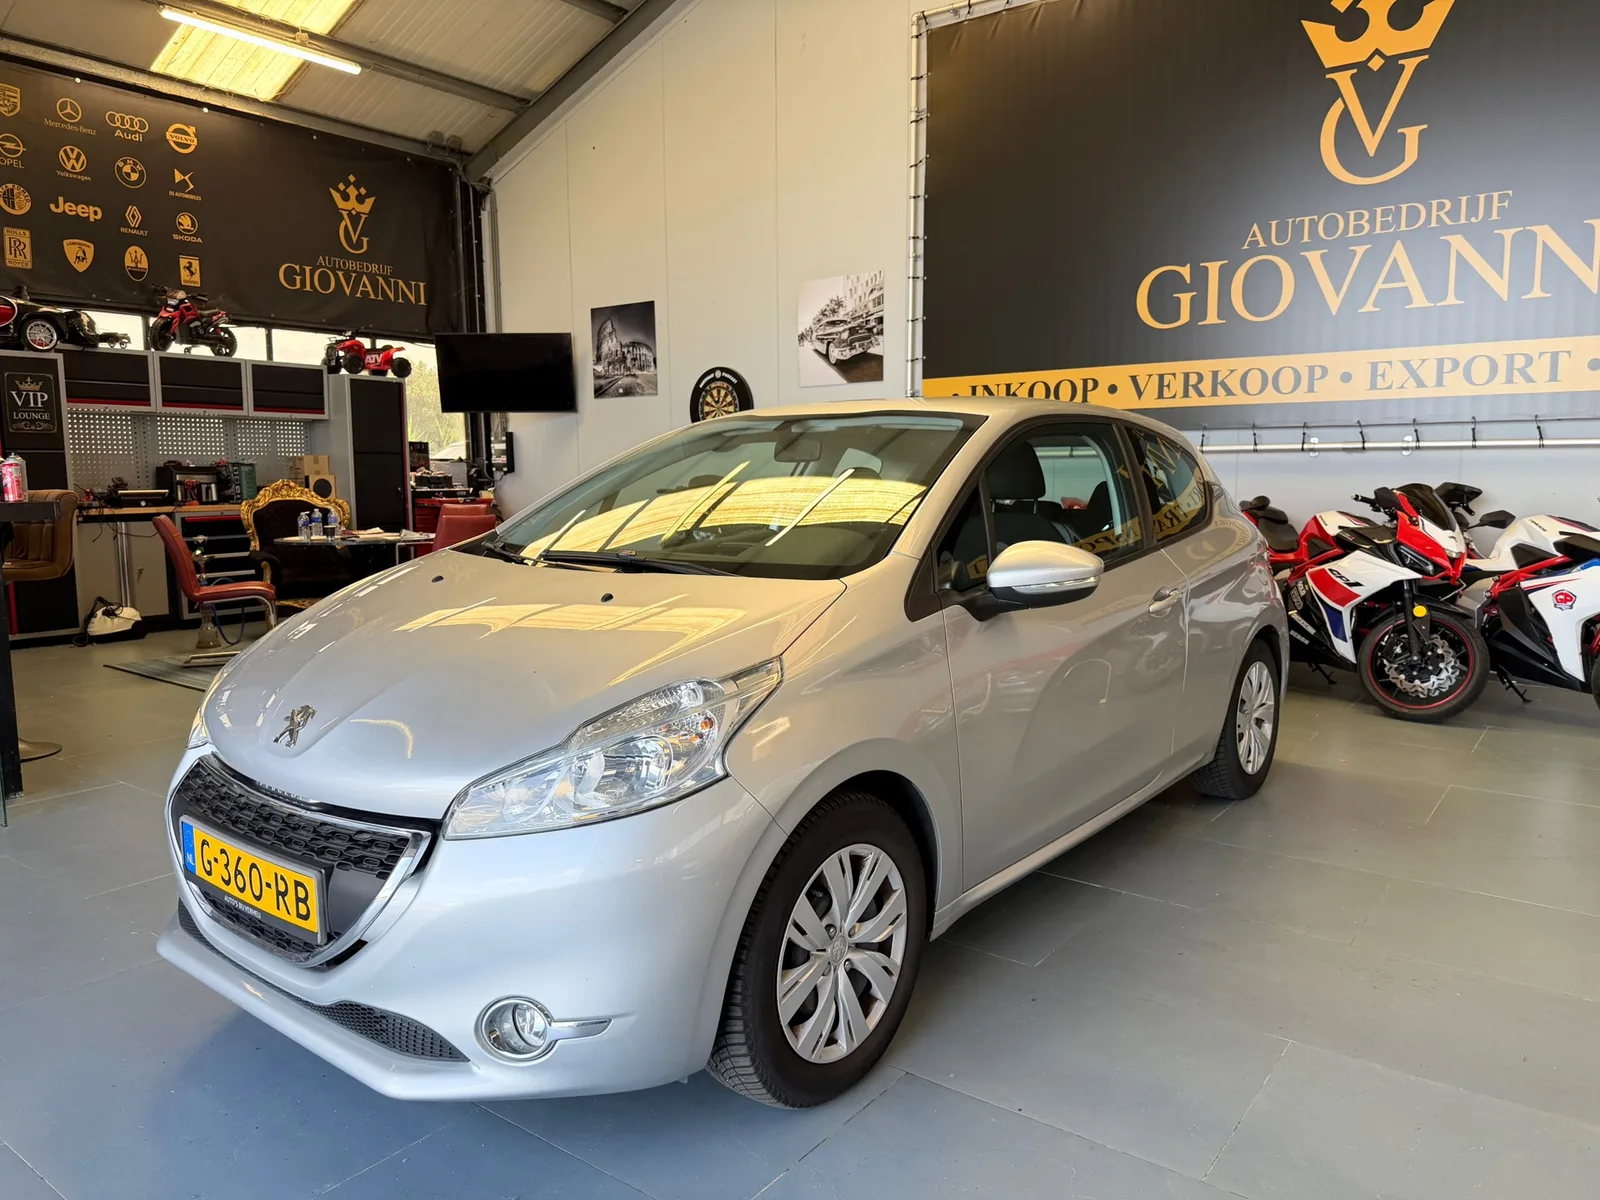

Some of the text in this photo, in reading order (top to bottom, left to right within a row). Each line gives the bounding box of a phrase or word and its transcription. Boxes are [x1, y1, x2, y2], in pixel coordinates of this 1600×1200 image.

[43, 118, 97, 136] Mercedes-Benz
[114, 129, 143, 142] Audi
[169, 133, 195, 144] VOLVO
[0, 157, 25, 169] OPEL
[56, 170, 92, 181] Volkswagen
[49, 195, 103, 222] Jeep
[1241, 190, 1513, 250] AUTOBEDRIJF
[120, 227, 148, 237] RENAULT
[317, 256, 393, 275] AUTOBEDRIJF
[278, 263, 428, 306] GIOVANNI
[365, 353, 382, 365] ATV
[1128, 364, 1329, 401] VERKOOP
[1366, 350, 1571, 391] EXPORT
[10, 390, 49, 407] VIP
[13, 412, 51, 420] LOUNGE
[186, 852, 195, 866] NL
[200, 839, 311, 922] G-360-RB
